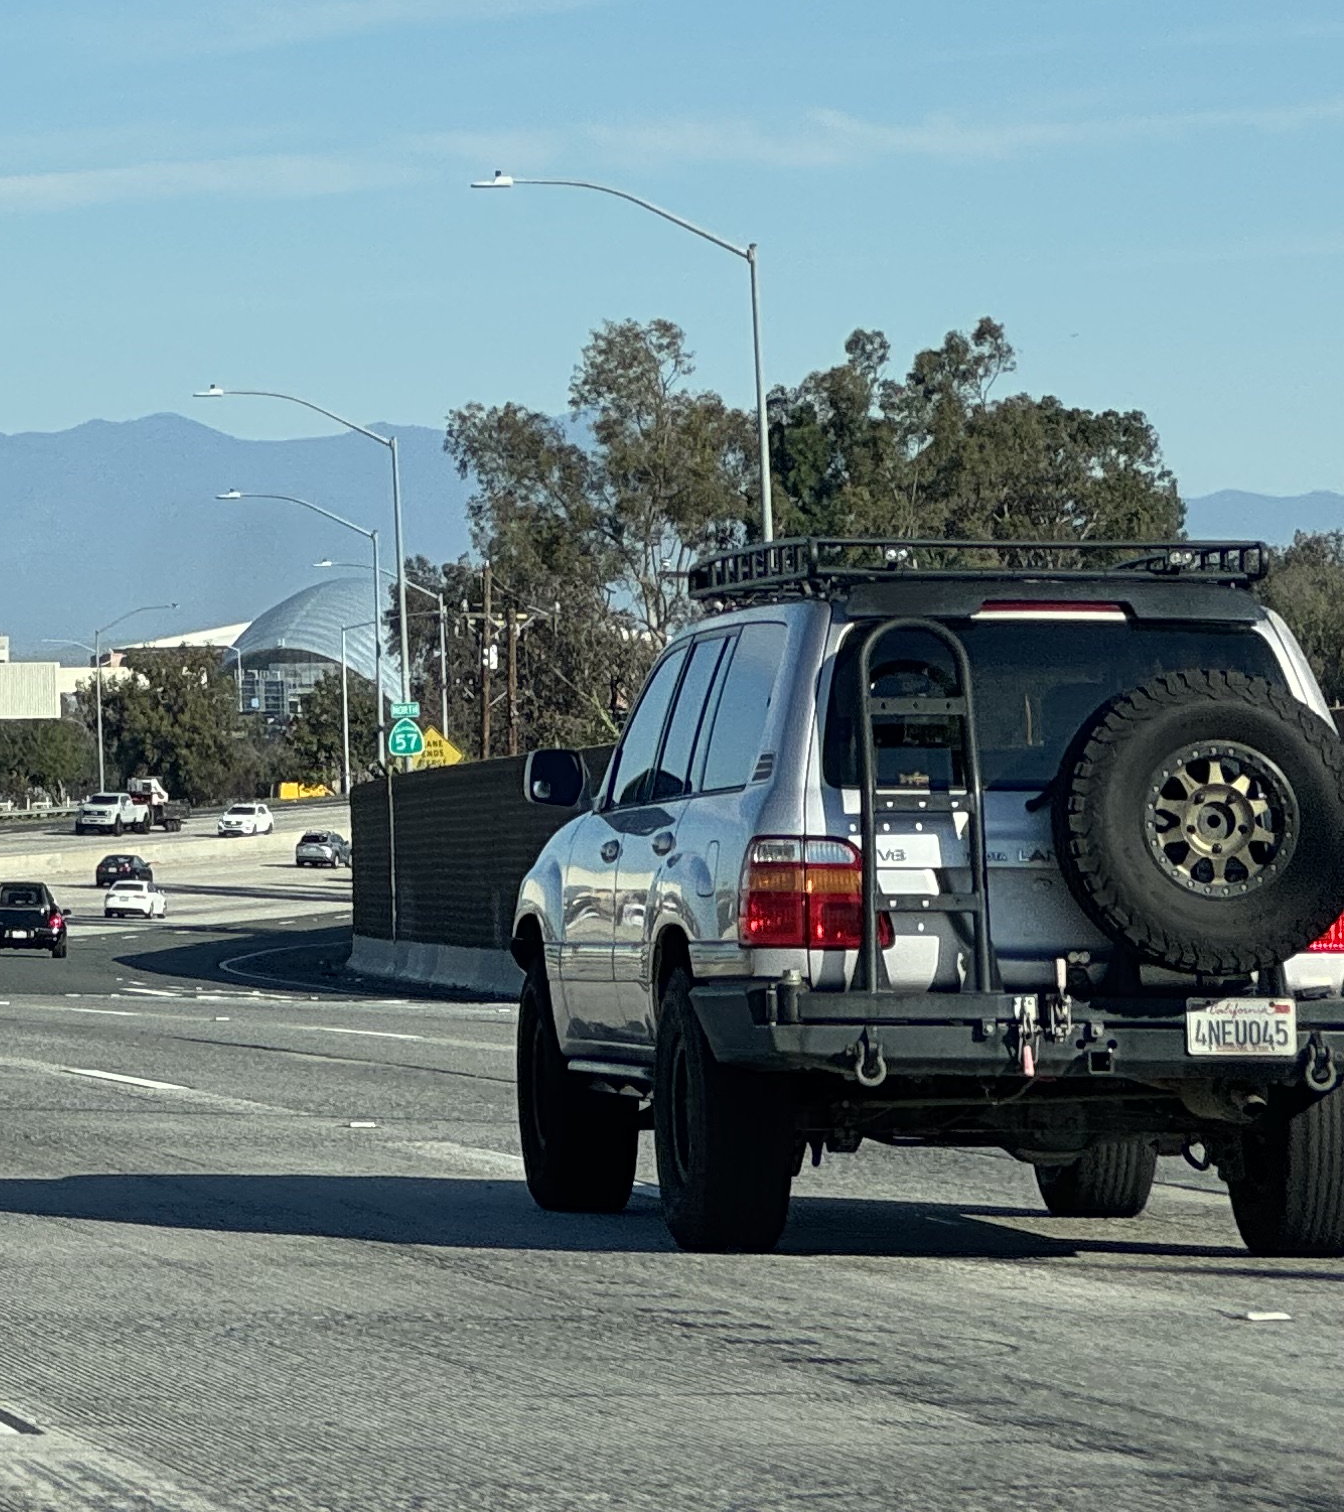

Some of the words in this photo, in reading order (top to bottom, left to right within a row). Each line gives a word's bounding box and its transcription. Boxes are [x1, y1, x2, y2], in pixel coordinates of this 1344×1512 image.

[395, 733, 418, 751] 57
[877, 848, 907, 862] V8
[1018, 849, 1057, 862] LAN
[1209, 1003, 1272, 1018] California
